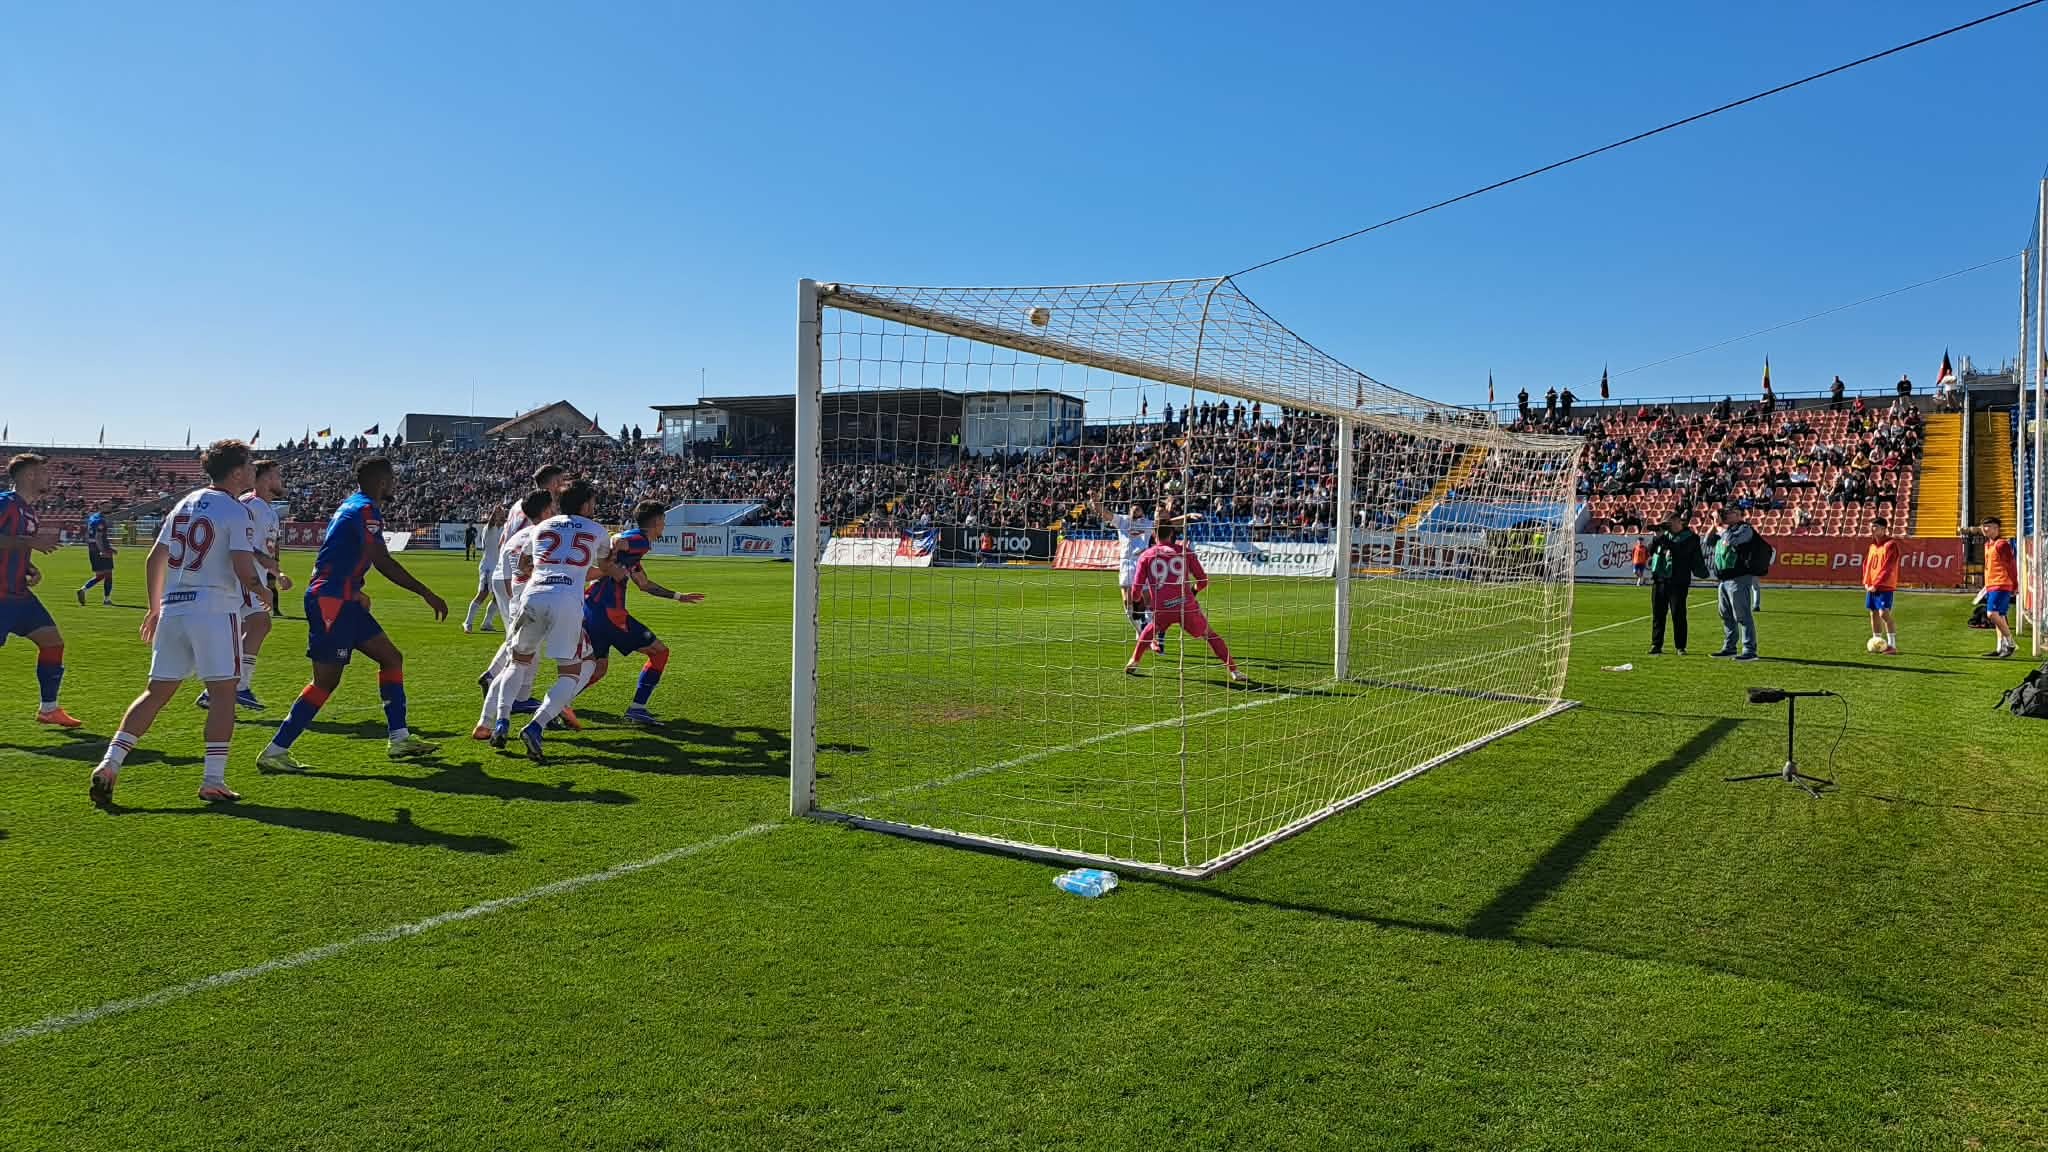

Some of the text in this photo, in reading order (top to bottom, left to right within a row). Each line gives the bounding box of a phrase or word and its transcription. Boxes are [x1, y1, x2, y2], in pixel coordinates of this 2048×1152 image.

[167, 515, 216, 572] 59
[536, 530, 595, 568] 25
[697, 535, 722, 545] MARTY
[1150, 556, 1185, 590] 99
[1779, 551, 1955, 569] casa parilor
